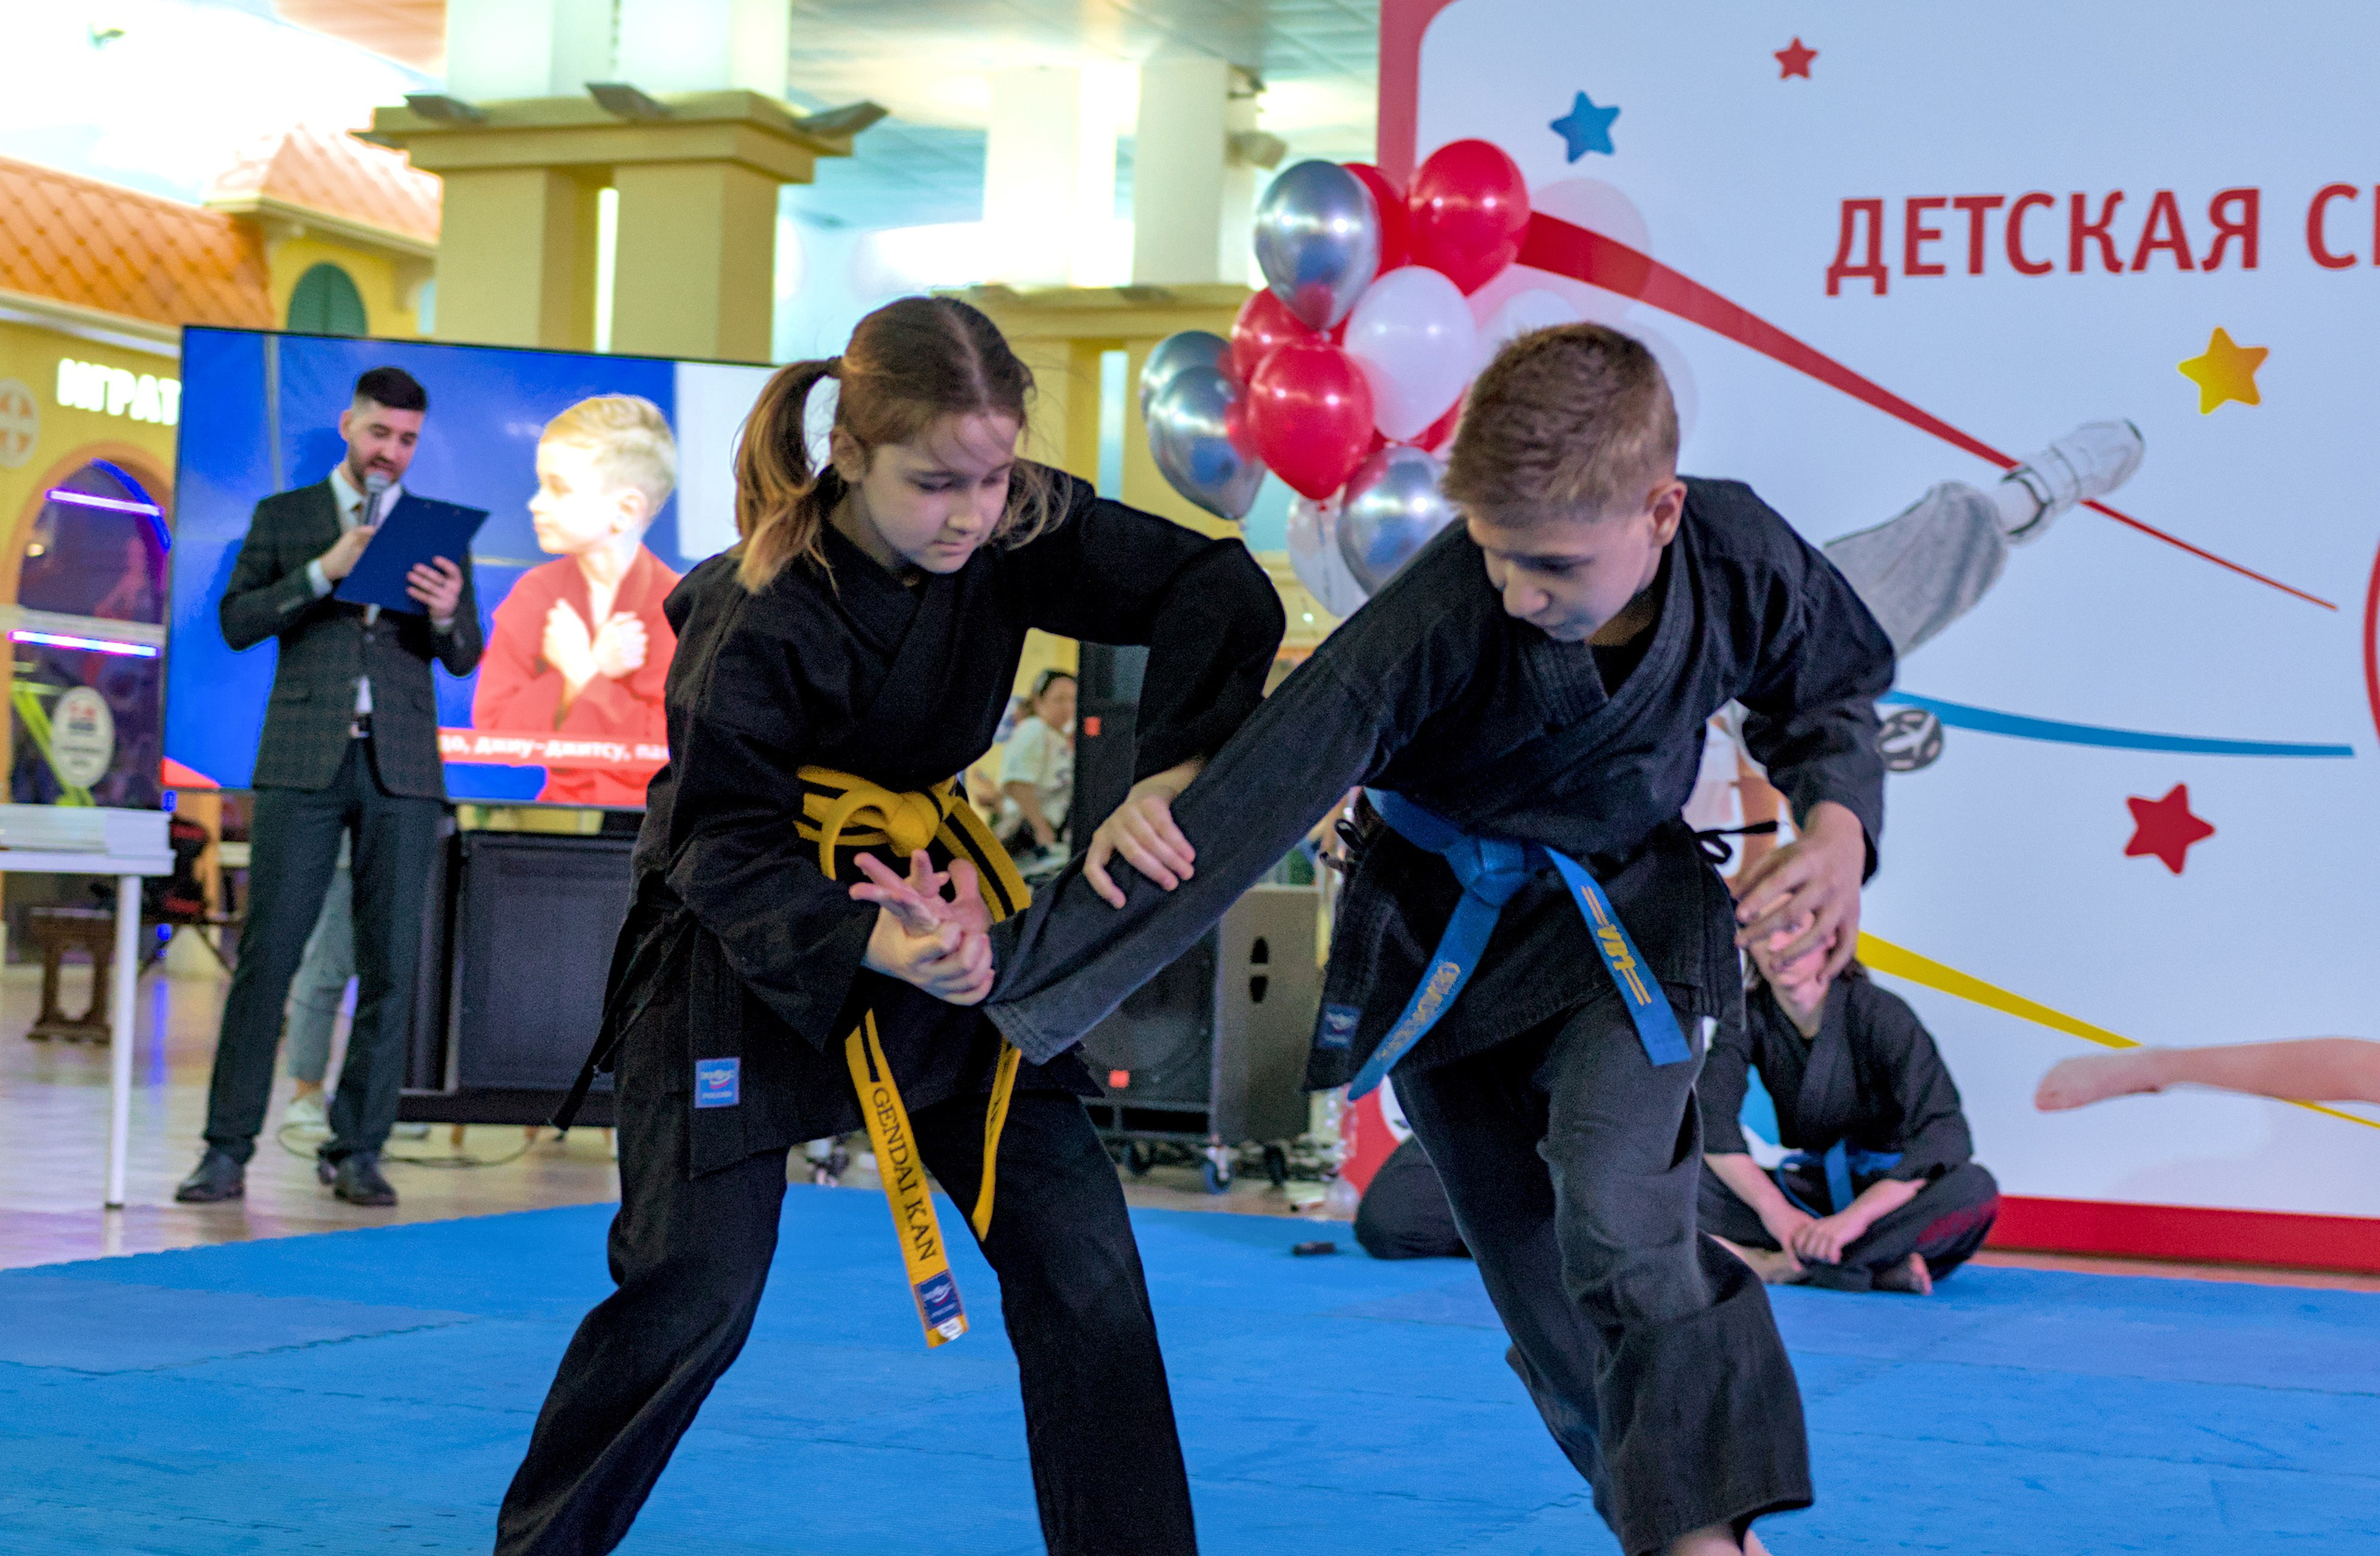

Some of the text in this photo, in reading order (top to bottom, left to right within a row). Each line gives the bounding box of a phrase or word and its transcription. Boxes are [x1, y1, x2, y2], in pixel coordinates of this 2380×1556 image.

[1825, 188, 2261, 297] ДЕТСКАЯ
[872, 1087, 919, 1196] GENDAI
[905, 1196, 938, 1262] KAN
